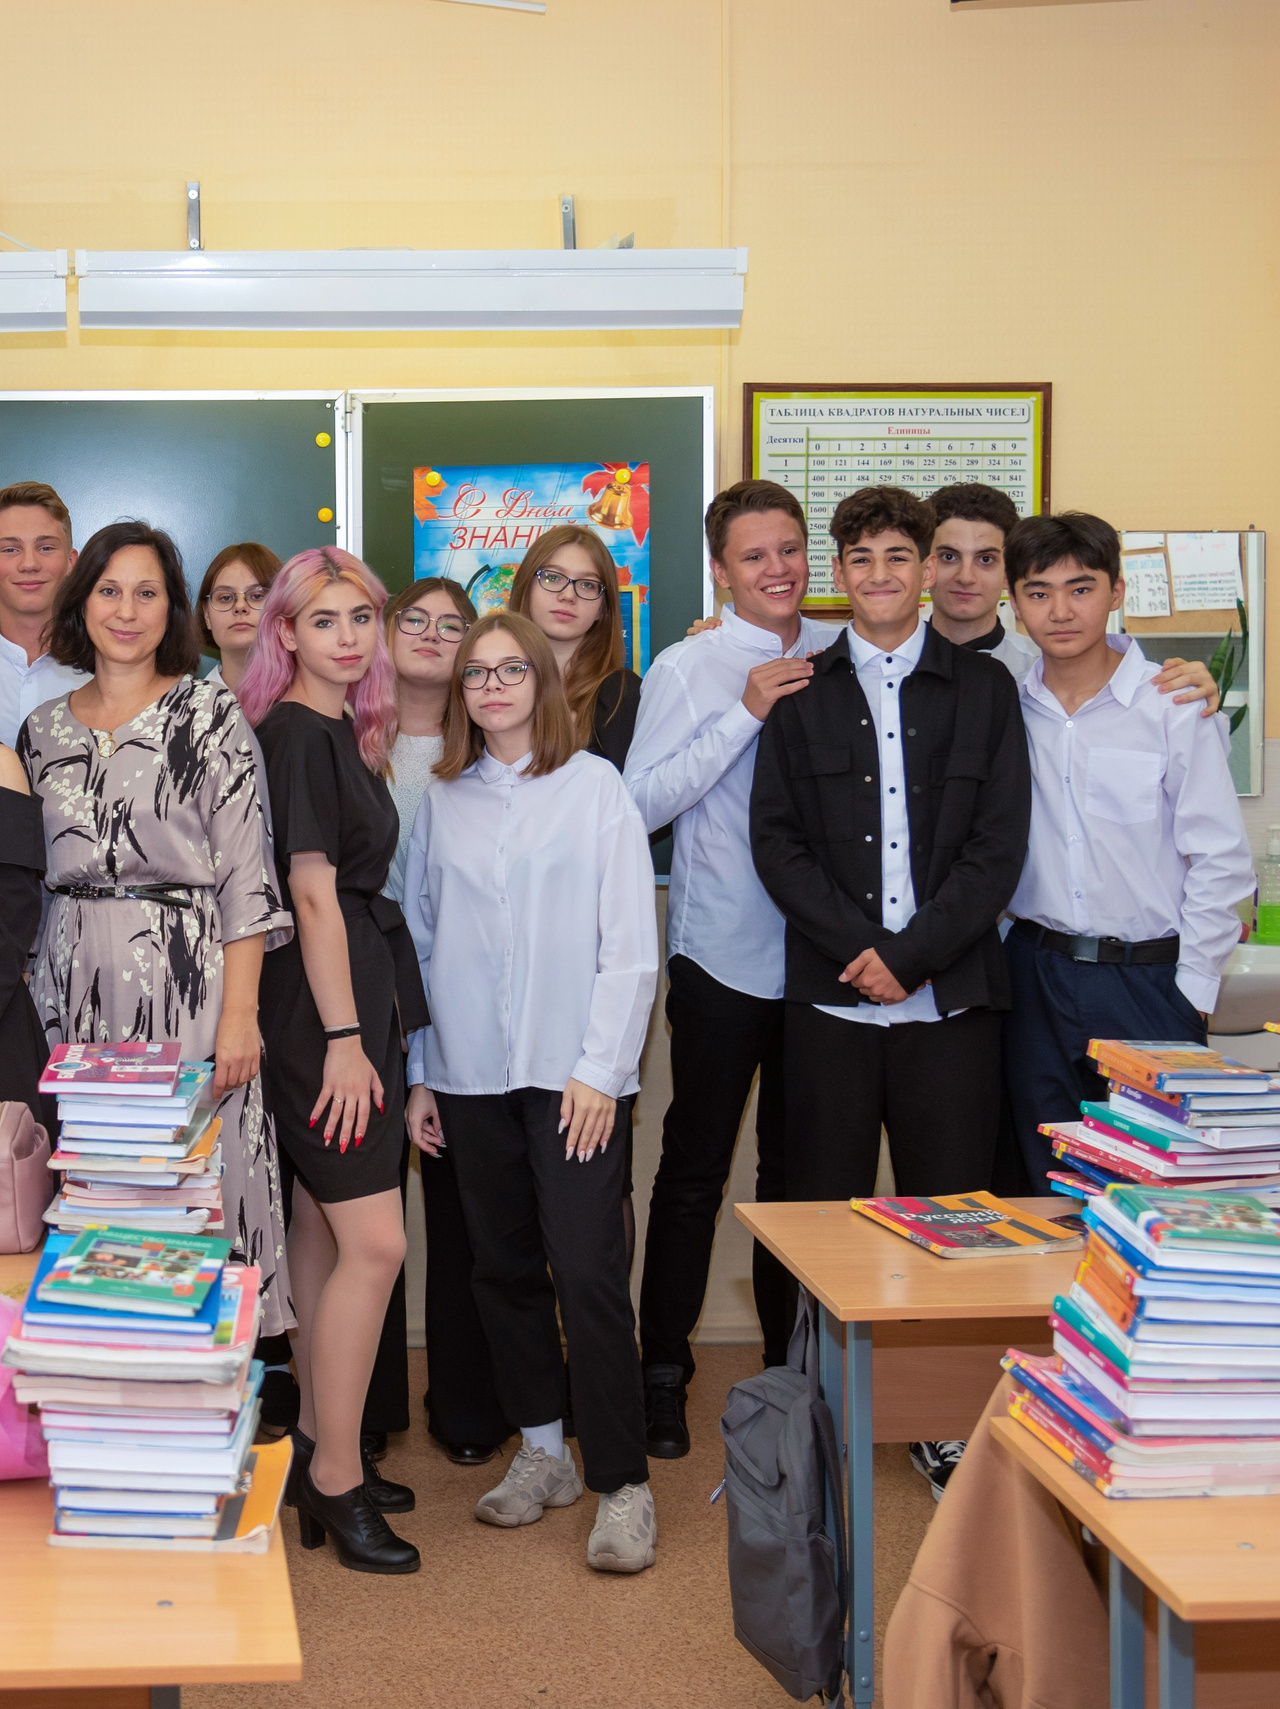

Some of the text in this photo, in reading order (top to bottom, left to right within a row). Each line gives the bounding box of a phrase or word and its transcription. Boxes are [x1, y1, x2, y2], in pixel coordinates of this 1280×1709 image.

[768, 407, 1025, 418] ТАБЛИЦА КВАДРАТОВ НАТУРАЛЬНЫХ ЧИСЕЛ
[887, 426, 931, 436] Единицы
[766, 435, 804, 445] Десятки
[815, 443, 1016, 451] 0 1 2 3 4 5 6 7 8 9
[438, 483, 574, 519] С Днём
[449, 519, 588, 550] ЗНАН
[897, 1208, 1004, 1222] Русский
[949, 1213, 1014, 1224] язык
